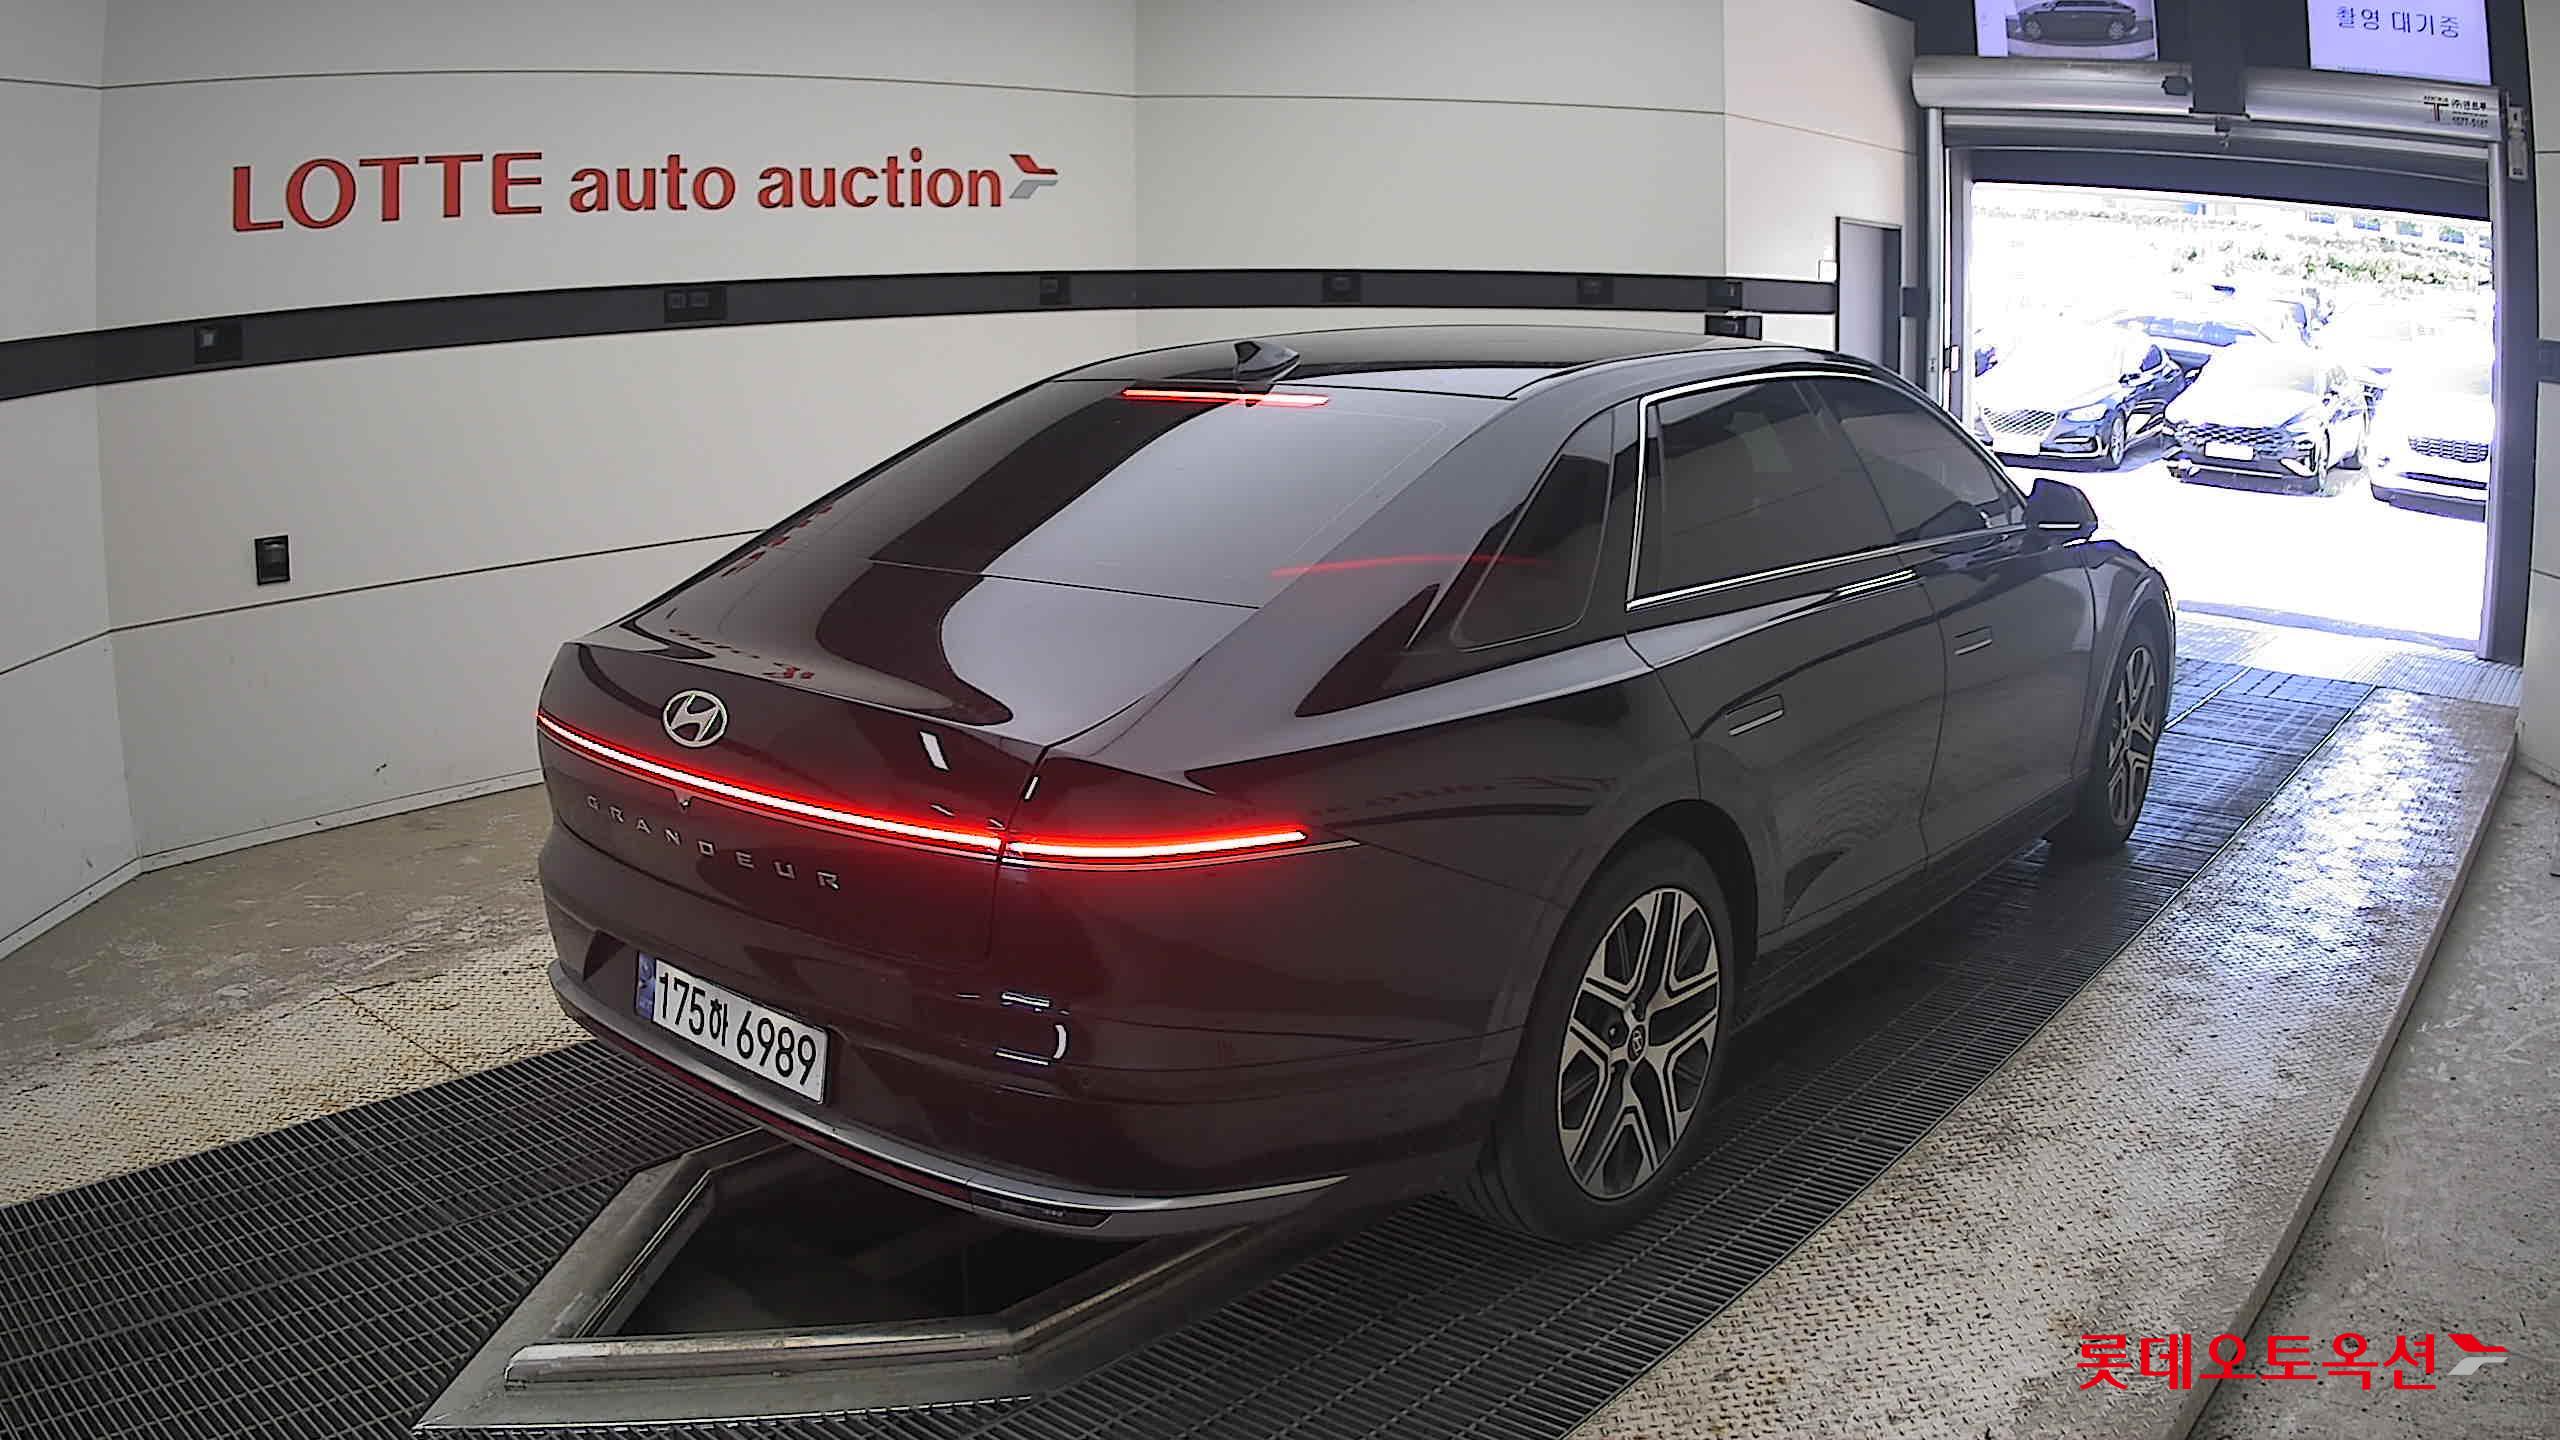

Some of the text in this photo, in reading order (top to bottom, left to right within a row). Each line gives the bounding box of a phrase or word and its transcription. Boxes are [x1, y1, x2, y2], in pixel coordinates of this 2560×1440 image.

[2336, 6, 2459, 38] 촬영 대기중
[232, 147, 1002, 232] LOTTE auto auction
[587, 795, 840, 890] GRANDEUR
[659, 972, 817, 1086] 175하 6989
